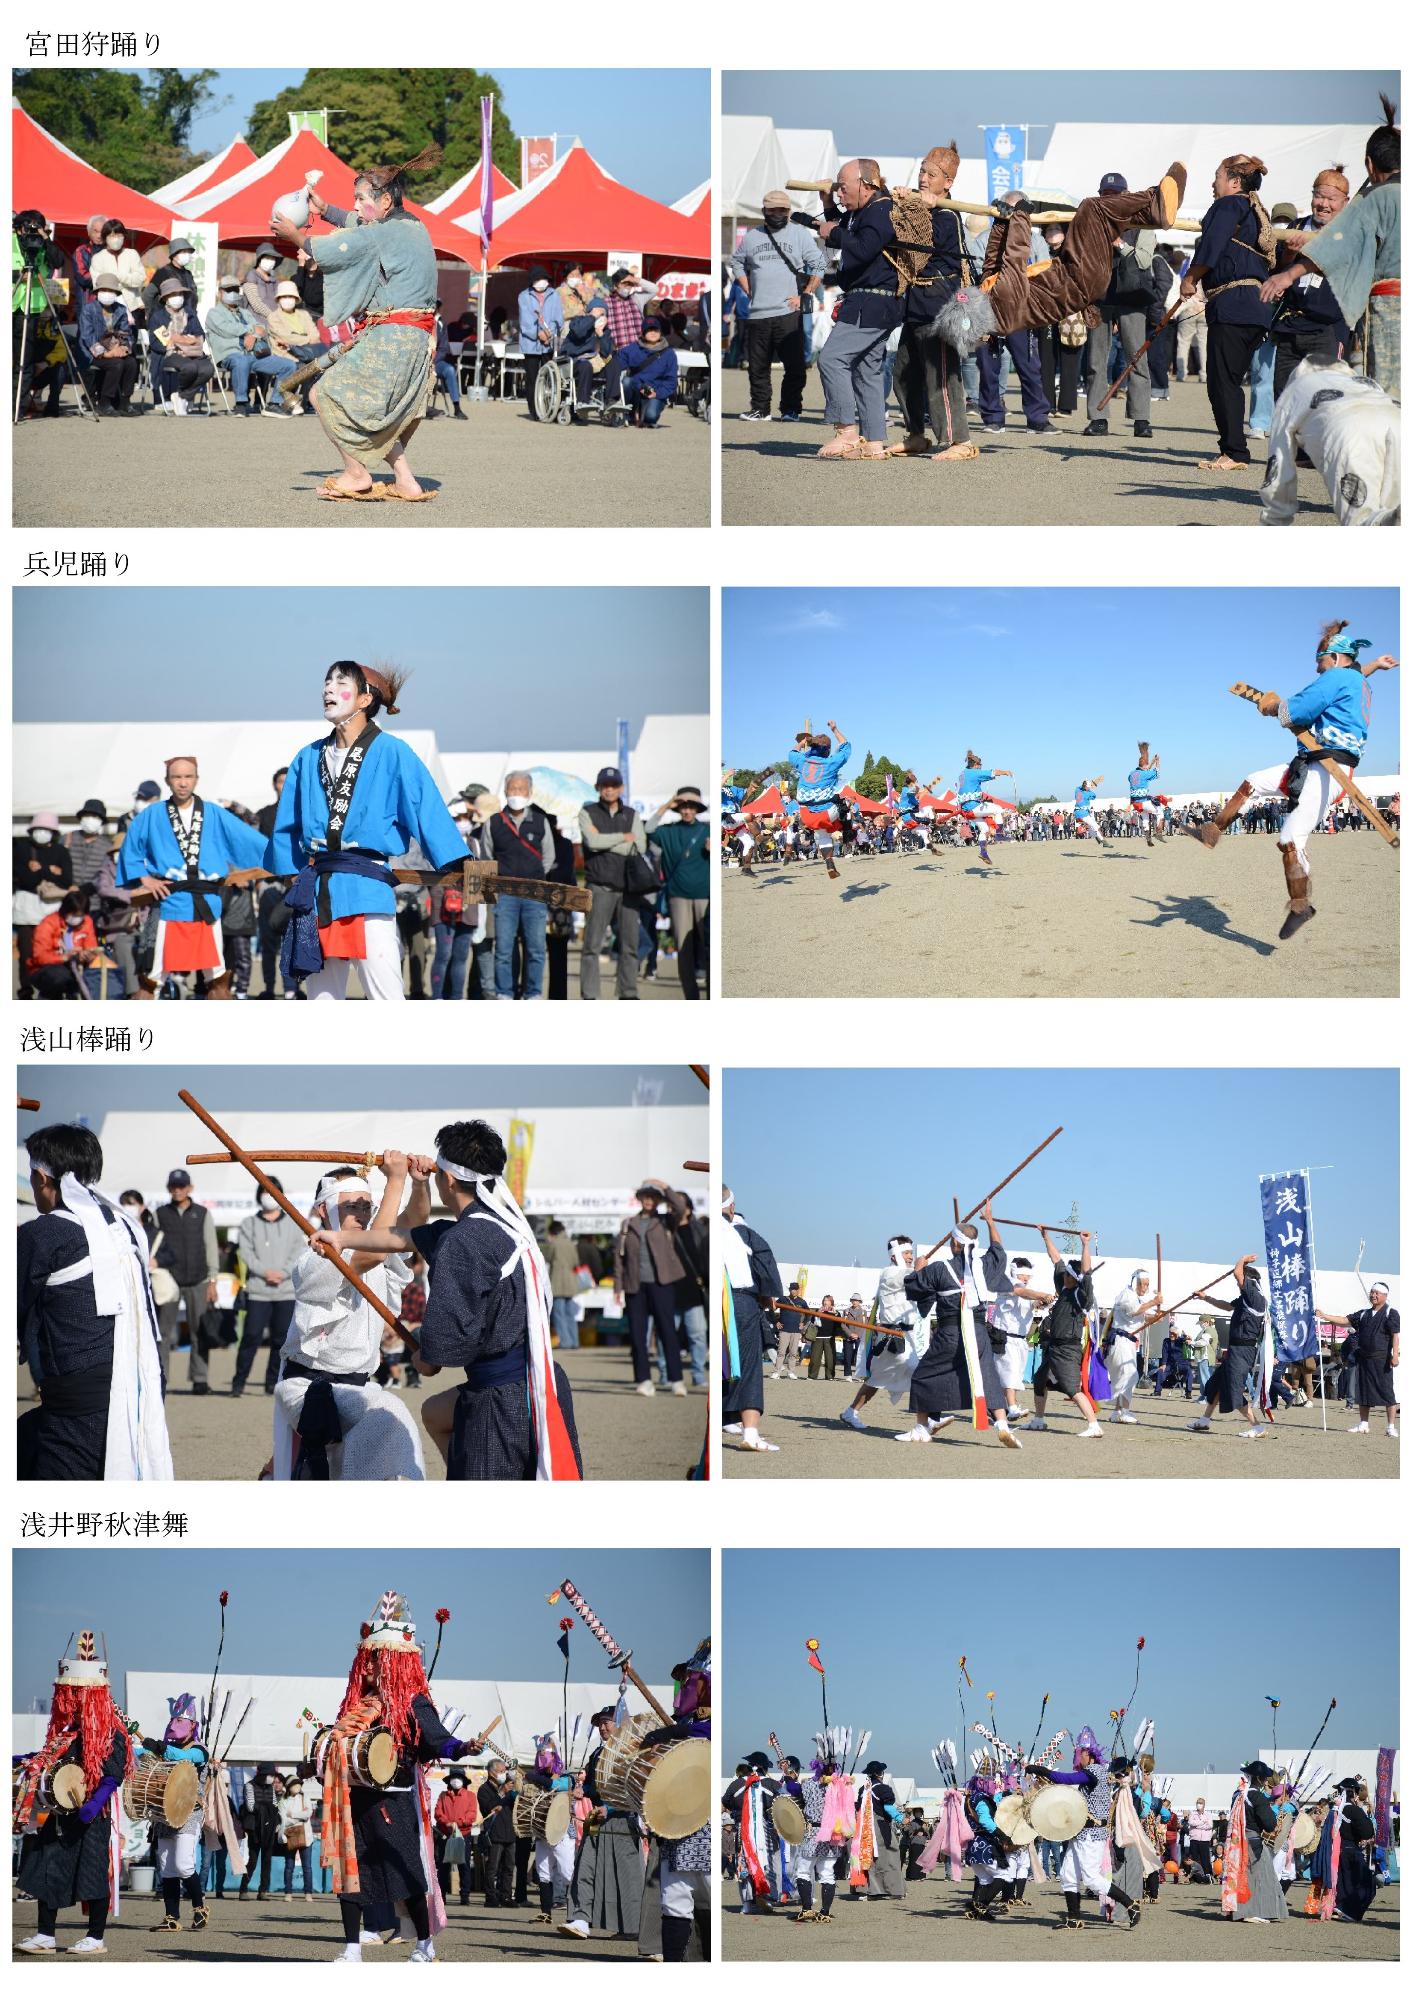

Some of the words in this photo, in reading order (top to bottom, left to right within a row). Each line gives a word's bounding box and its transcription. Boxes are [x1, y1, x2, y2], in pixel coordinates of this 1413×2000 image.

[329, 746, 364, 831] 尾原友励会
[1275, 1187, 1310, 1348] 浅山棒踊り
